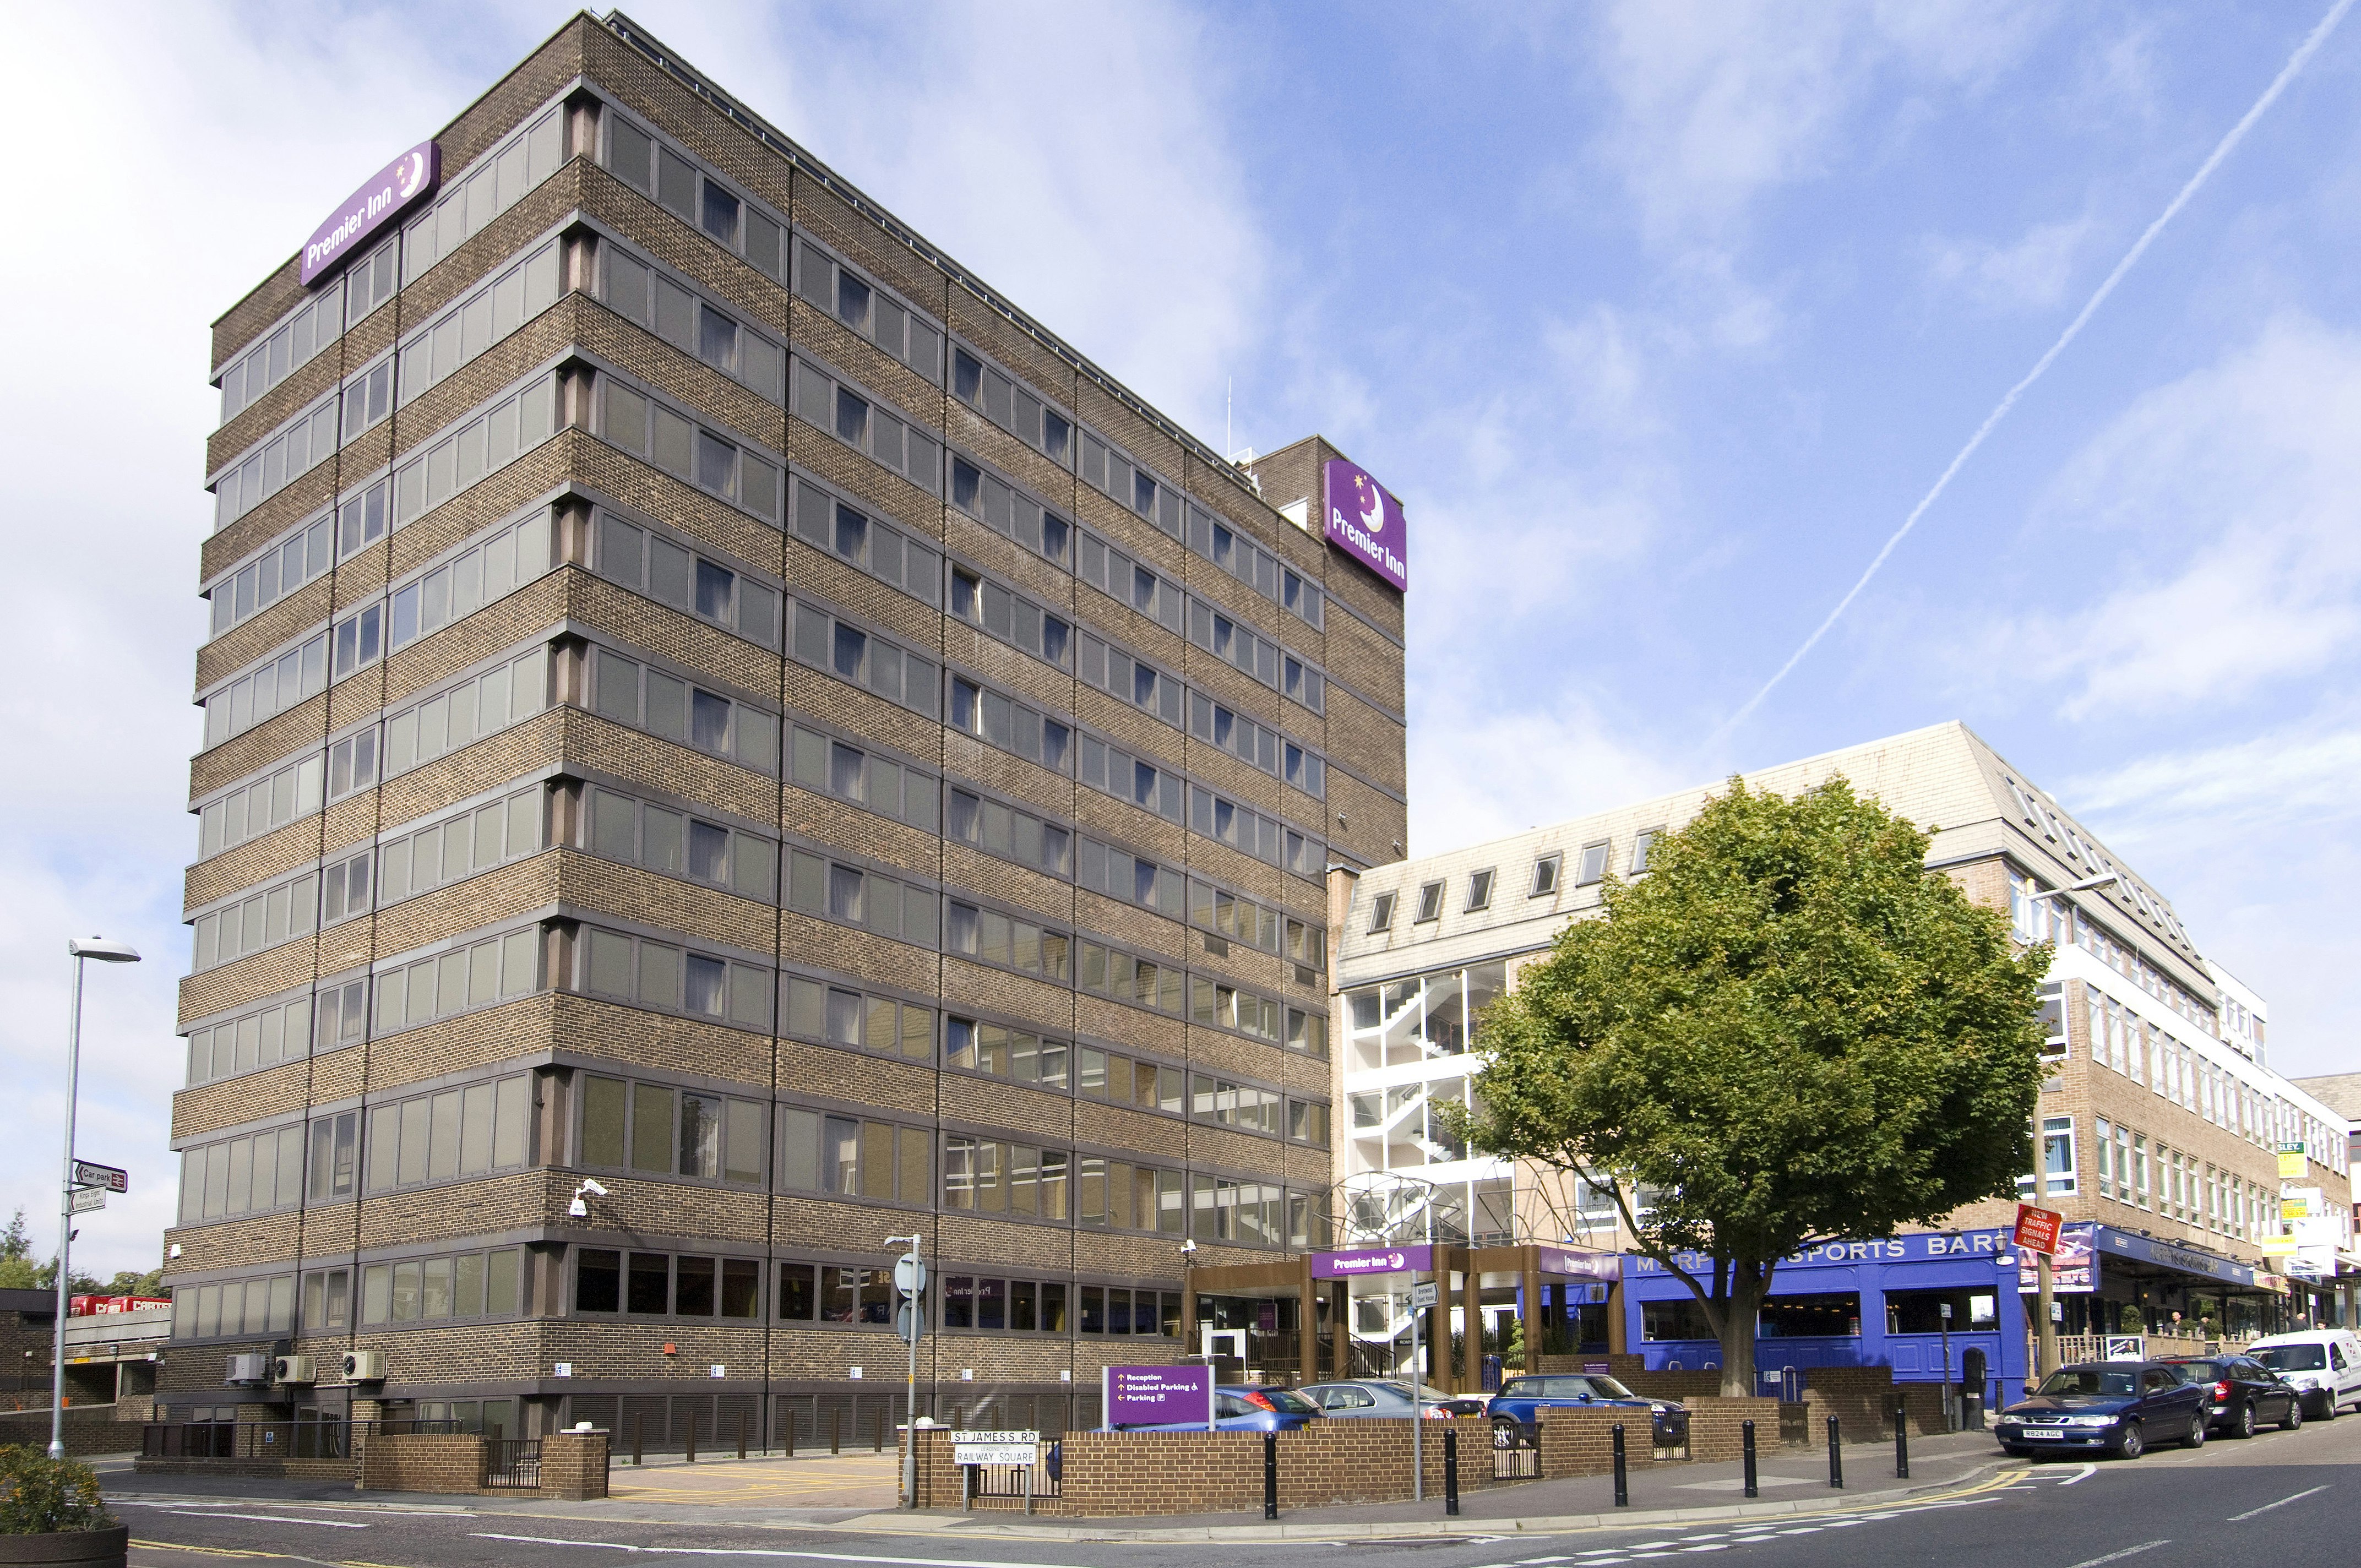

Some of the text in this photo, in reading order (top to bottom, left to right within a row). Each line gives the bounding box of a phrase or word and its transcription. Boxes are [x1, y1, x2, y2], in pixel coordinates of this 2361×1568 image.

[307, 186, 391, 269] Premier Inn
[1333, 507, 1405, 580] Premier Inn
[84, 1169, 111, 1182] Car park
[2031, 1210, 2048, 1220] NEW
[2025, 1217, 2053, 1231] TRAFFIC
[2021, 1227, 2050, 1241] SIGNALS
[1928, 1234, 1994, 1255] BAR
[2022, 1237, 2046, 1249] AHEAD
[1334, 1257, 1387, 1269] Premier Inn
[1161, 1384, 1189, 1392] Parking
[955, 1433, 967, 1441] ST
[1021, 1433, 1035, 1441] RD
[958, 1452, 1033, 1462] RAILWAY SQUARE
